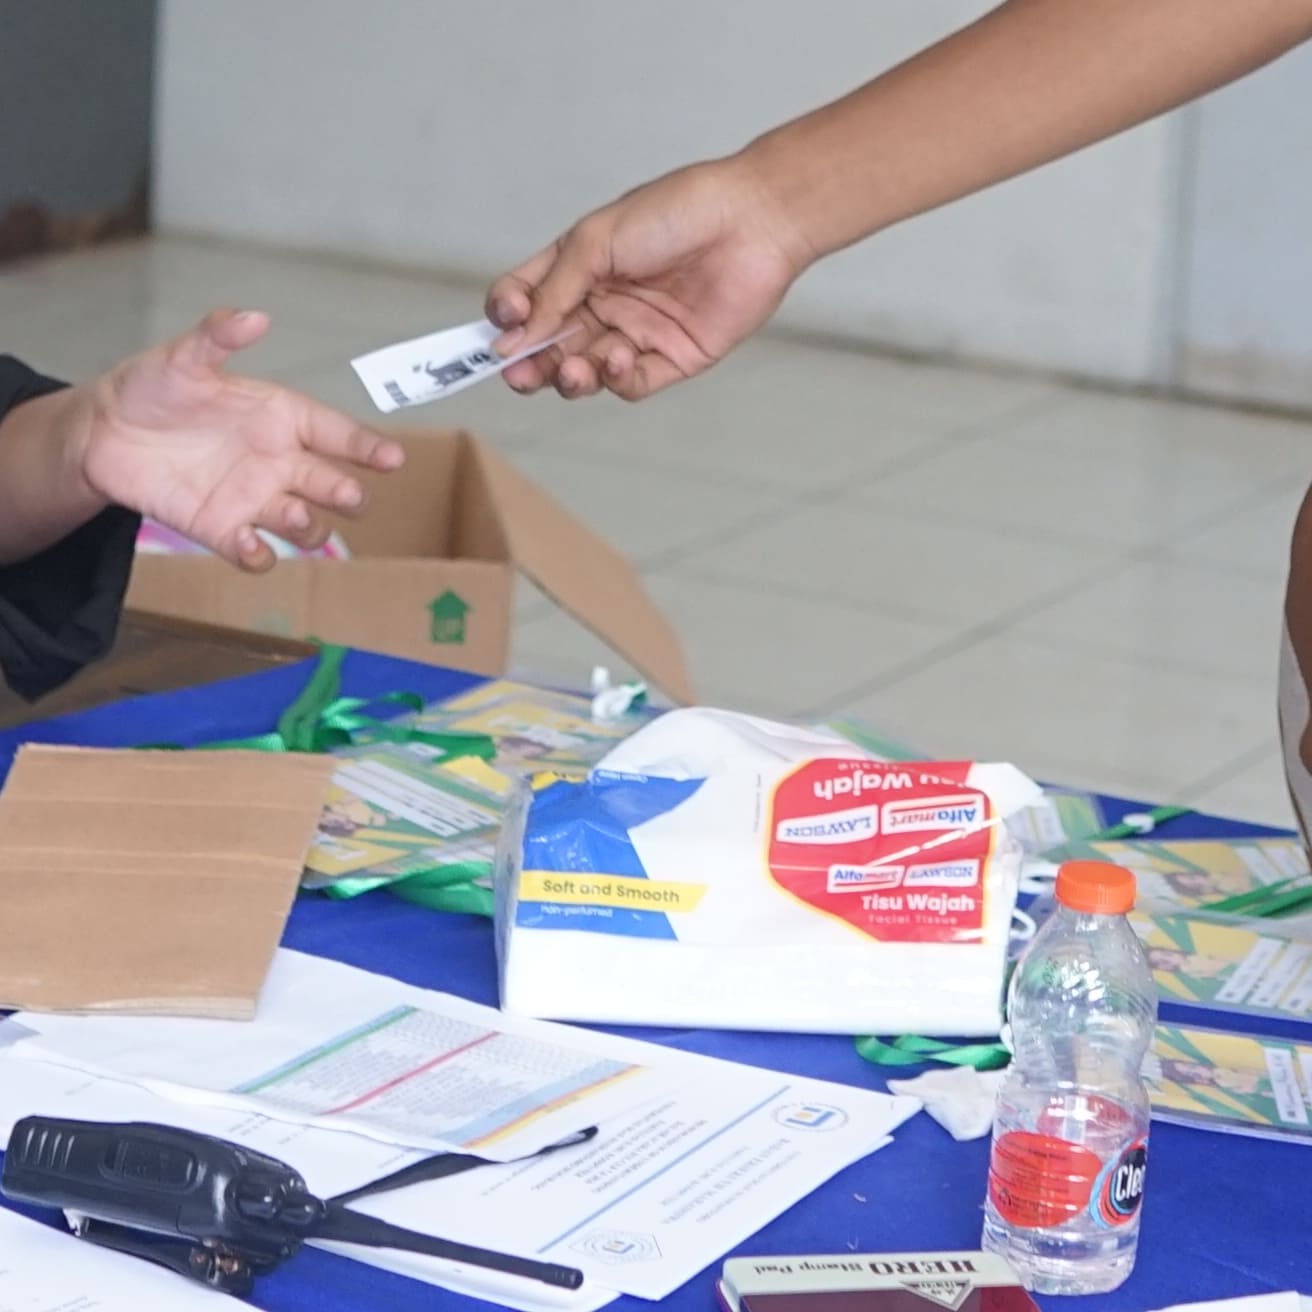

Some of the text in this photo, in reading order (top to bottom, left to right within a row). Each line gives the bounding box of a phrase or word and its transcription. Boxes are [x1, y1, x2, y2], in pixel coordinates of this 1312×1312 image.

[813, 770, 913, 801] Wajah
[890, 806, 977, 828] Alfamart
[543, 879, 680, 903] Soft and Smooth
[861, 893, 975, 916] Tisu Wajah
[869, 914, 958, 926] Facial Tissue
